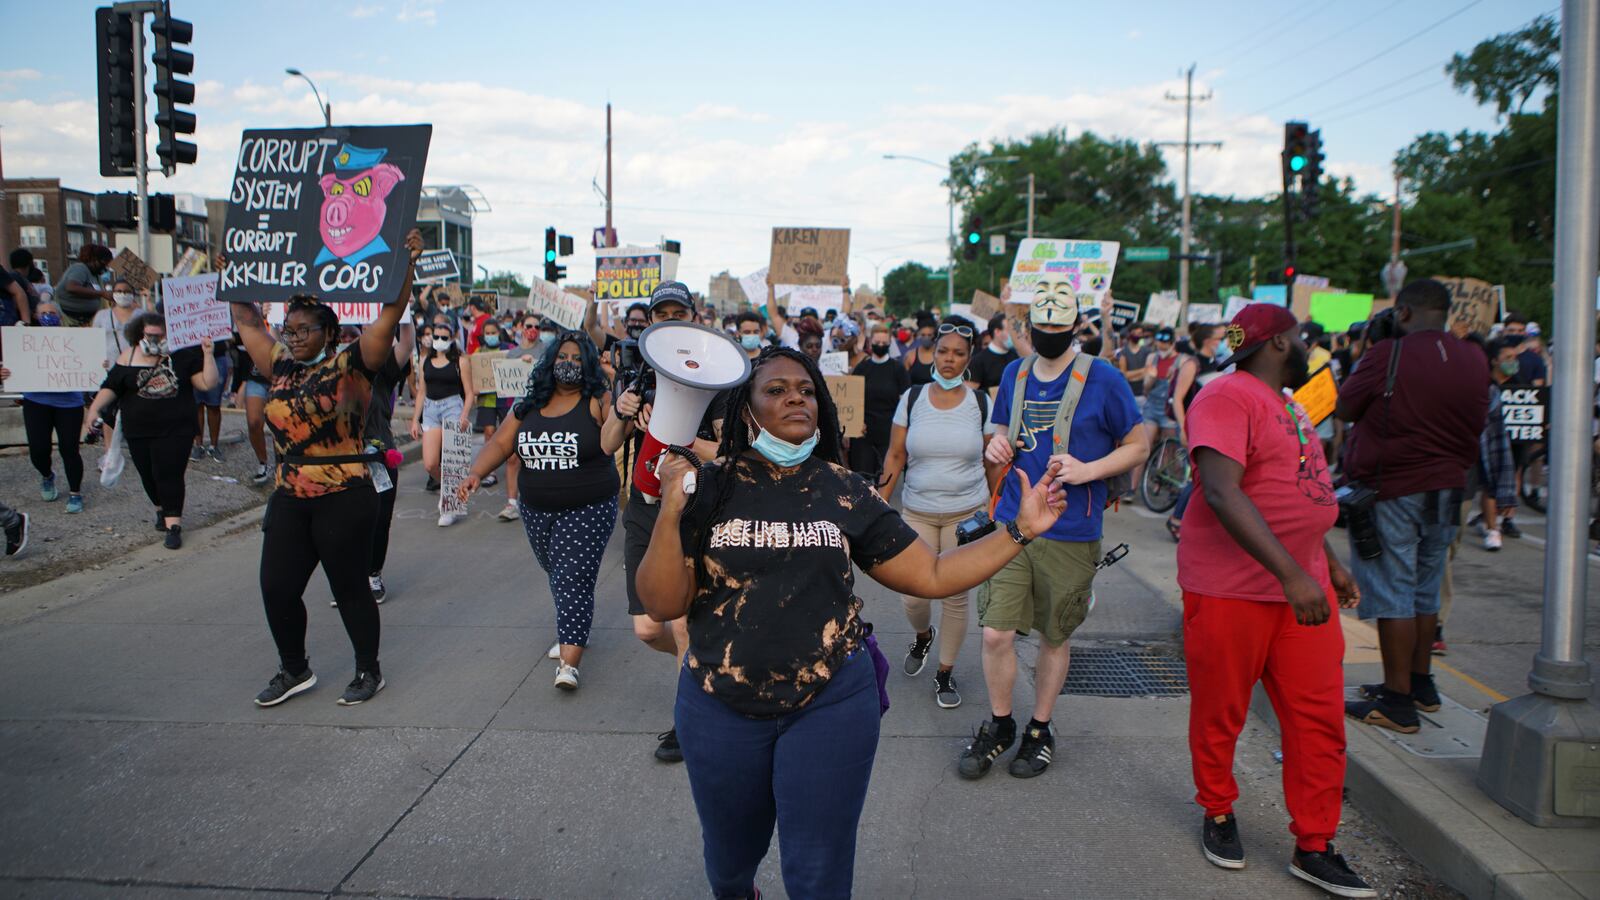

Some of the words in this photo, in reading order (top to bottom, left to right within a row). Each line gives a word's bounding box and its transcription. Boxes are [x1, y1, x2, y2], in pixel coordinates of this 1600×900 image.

[238, 138, 337, 175] CORRUPT
[232, 177, 302, 211] SYSTEM
[225, 228, 297, 254] CORRUPT
[773, 228, 819, 245] KAREN
[1032, 243, 1057, 259] ALL
[221, 260, 307, 291] KKKILLER
[319, 262, 383, 292] COPS
[641, 267, 660, 278] THE
[792, 262, 823, 276] STOP
[597, 279, 660, 299] POLICE
[22, 334, 75, 353] BLACK
[37, 354, 83, 370] LIVES
[47, 372, 99, 388] MATTER
[518, 431, 580, 443] BLACK
[518, 444, 577, 458] LIVES
[524, 458, 580, 470] MATTER
[710, 518, 752, 548] BLACK
[754, 520, 790, 548] LIVES
[792, 520, 842, 548] MATTER
